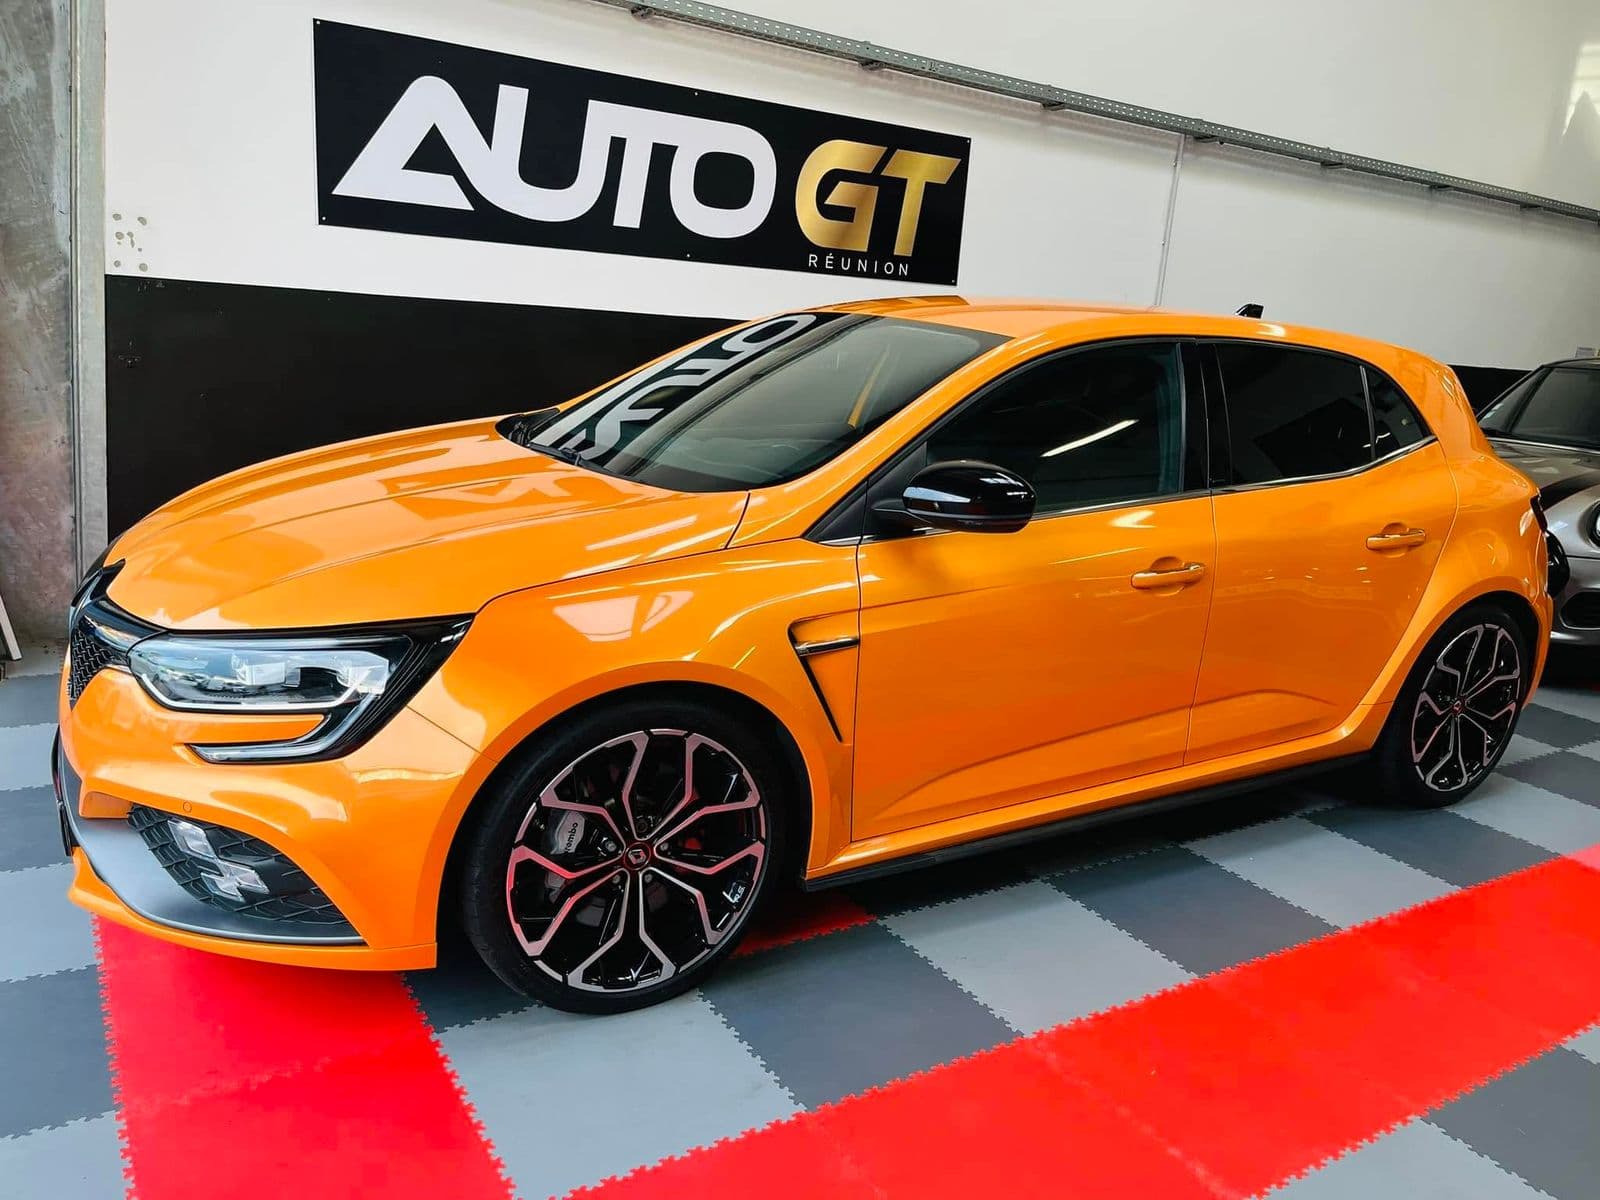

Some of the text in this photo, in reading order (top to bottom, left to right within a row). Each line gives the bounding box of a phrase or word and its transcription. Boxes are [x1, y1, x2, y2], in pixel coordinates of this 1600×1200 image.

[332, 75, 961, 257] AUTO GT
[808, 253, 909, 277] RÉUNION
[565, 822, 579, 853] rembo
